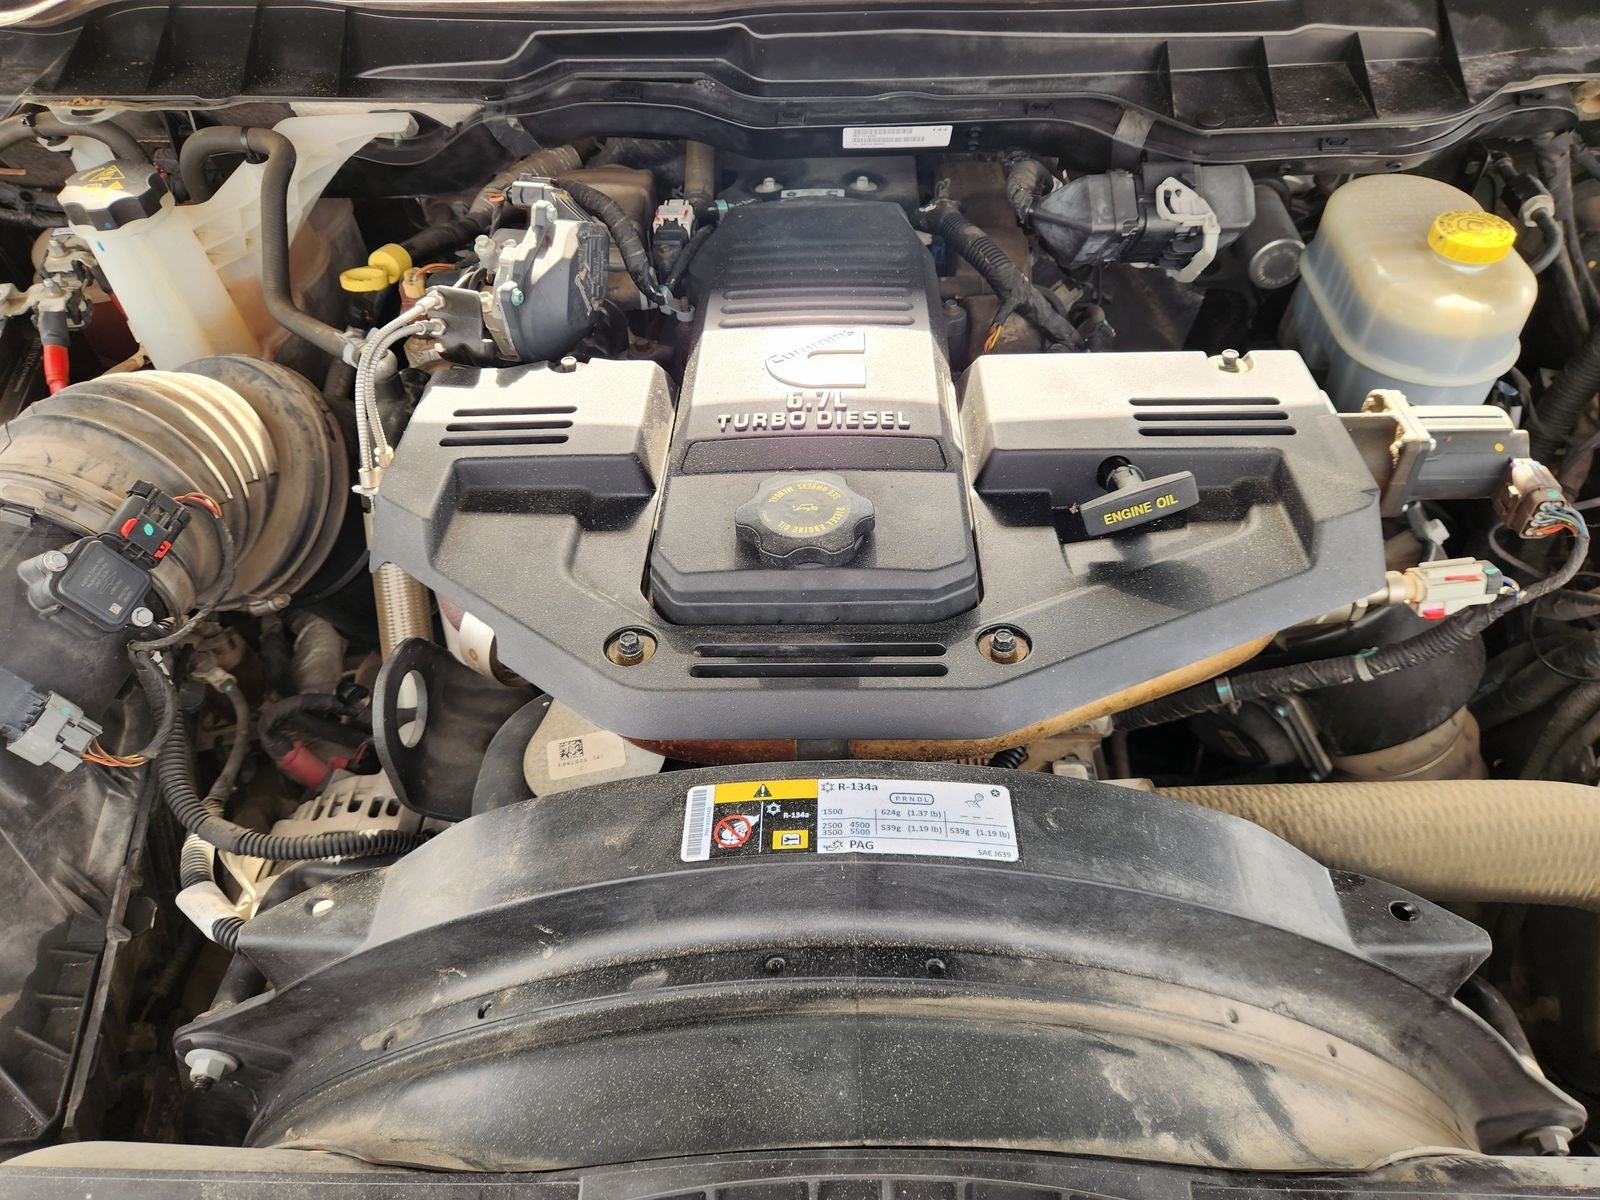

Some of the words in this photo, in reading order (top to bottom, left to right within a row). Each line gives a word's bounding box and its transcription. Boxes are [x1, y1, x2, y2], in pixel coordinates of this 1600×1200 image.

[768, 330, 855, 364] Cummins
[786, 391, 848, 412] 6.7L
[717, 410, 807, 433] TURBO
[815, 410, 911, 430] DIESEL
[1103, 501, 1153, 525] ENGINE
[1156, 494, 1179, 508] OIL
[777, 520, 792, 531] OIL
[791, 522, 827, 534] ENGINE
[838, 782, 878, 791] R-134a
[783, 811, 810, 819] R-134a
[881, 809, 901, 817] 624g
[907, 810, 928, 818] (1.37
[930, 810, 942, 819] lb)
[880, 824, 902, 833] 539g
[907, 825, 929, 833] (1.19
[931, 826, 943, 834] lb)
[949, 827, 970, 836] 539g
[976, 828, 998, 838] (1.19
[999, 830, 1011, 840] lb)
[849, 840, 875, 850] PAG
[977, 849, 993, 857] SAE
[994, 850, 1012, 859] J639
